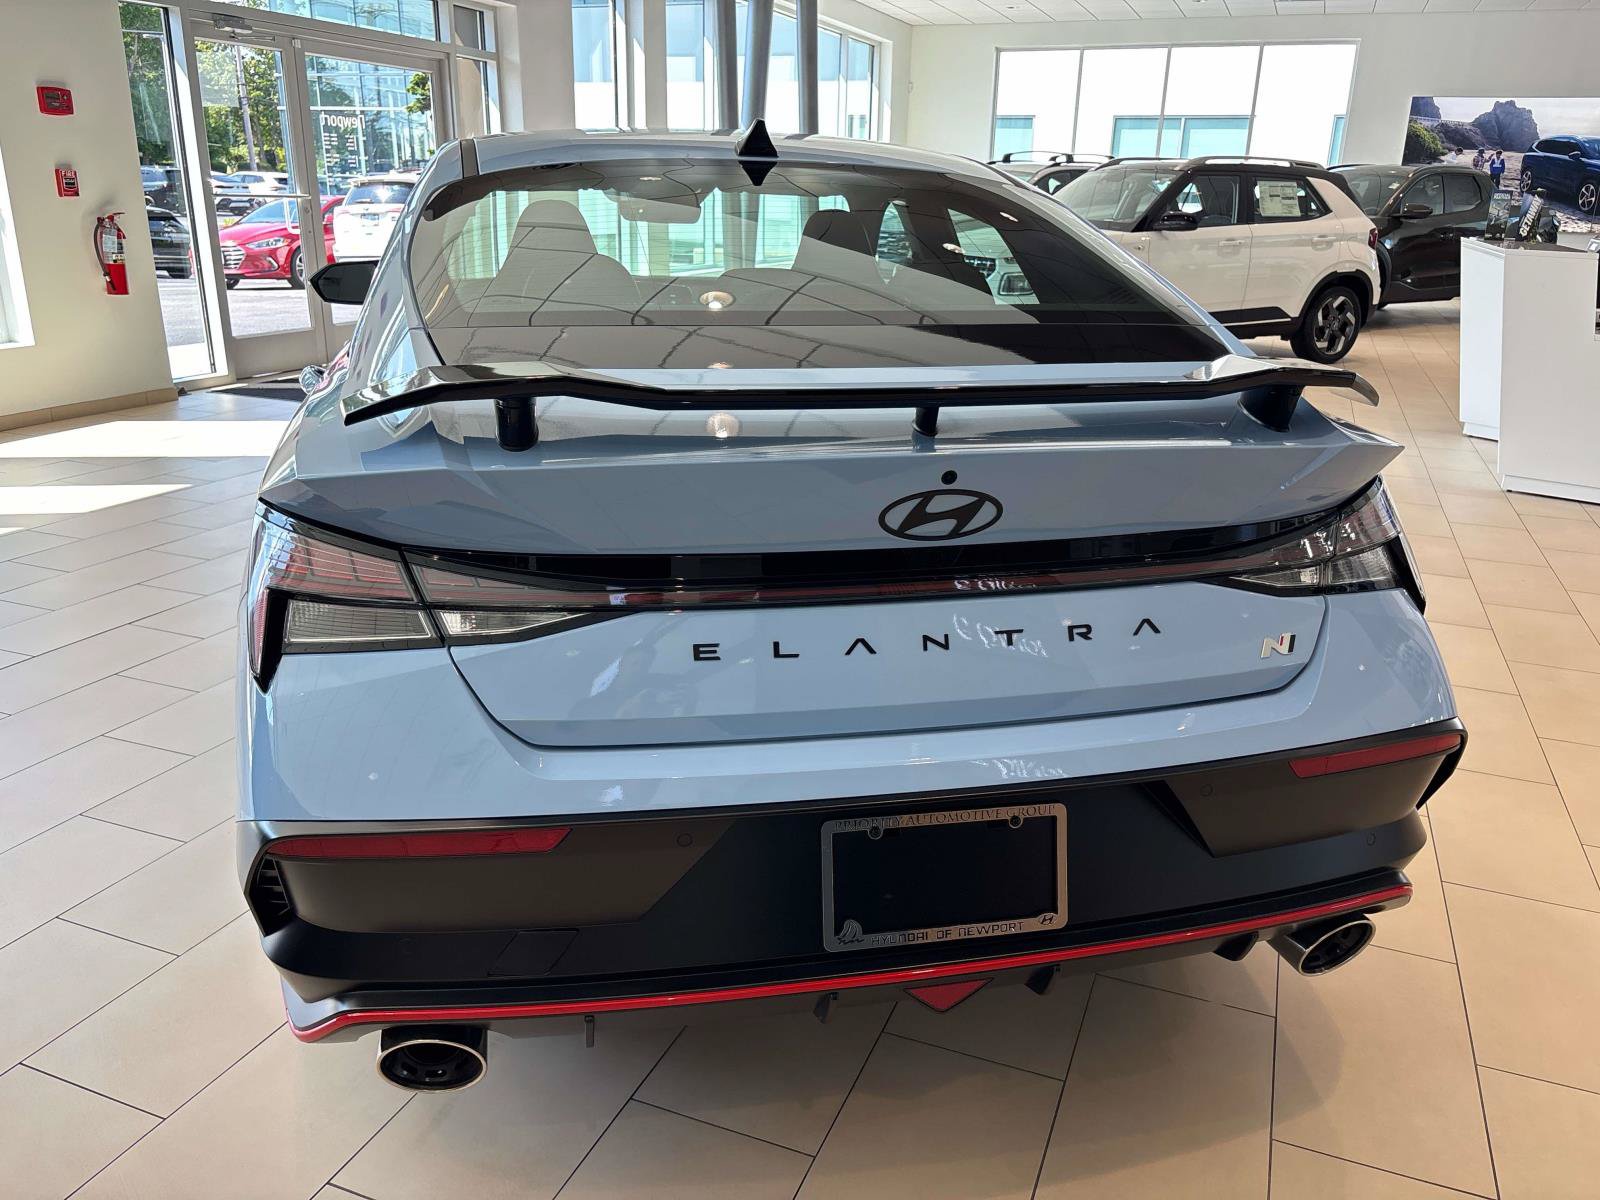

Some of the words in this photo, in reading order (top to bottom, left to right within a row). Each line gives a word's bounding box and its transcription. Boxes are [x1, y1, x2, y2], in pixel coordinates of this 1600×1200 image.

[62, 167, 75, 177] FIRE
[1519, 194, 1542, 237] GETAWAY
[693, 618, 1162, 661] ELANTRA
[835, 816, 900, 831] PRIORITY
[906, 809, 1001, 825] AUTOMOTIVE
[1006, 805, 1054, 817] GROUP
[936, 929, 952, 940] OF
[958, 921, 1024, 937] NEWPORT
